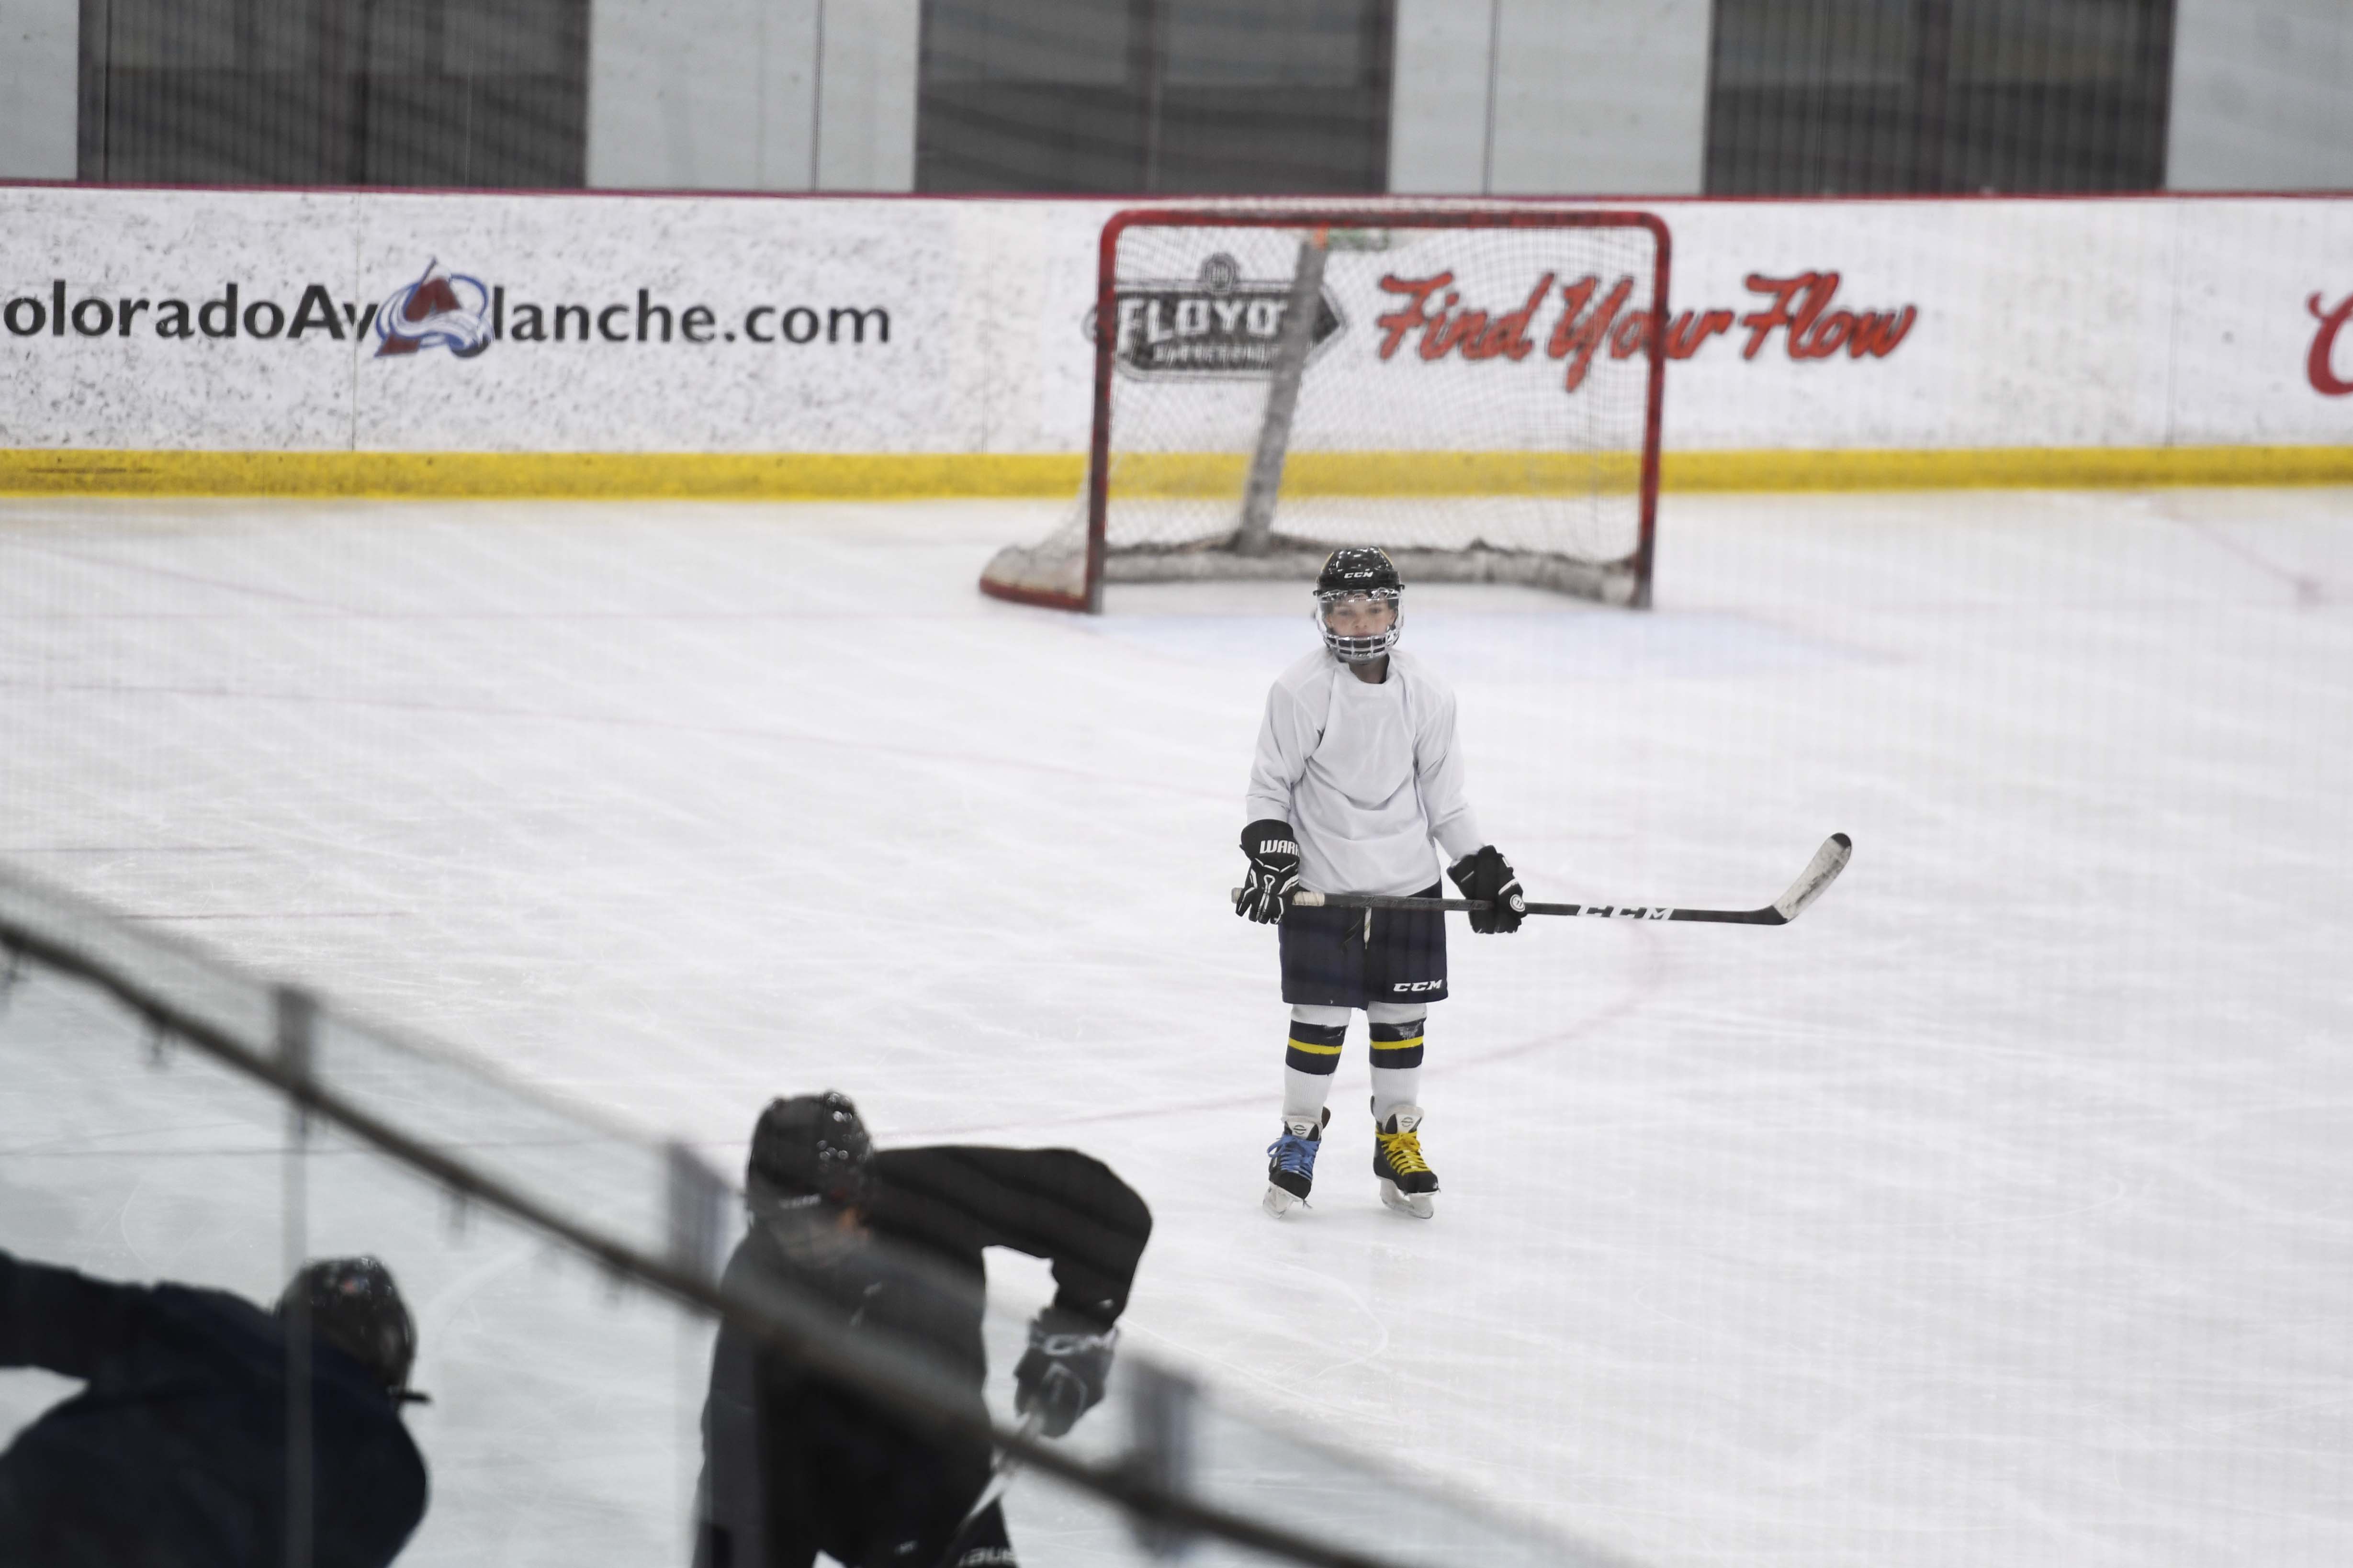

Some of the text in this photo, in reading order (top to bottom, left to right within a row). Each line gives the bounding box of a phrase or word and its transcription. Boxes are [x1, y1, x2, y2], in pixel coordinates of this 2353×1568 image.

[1376, 270, 1917, 393] Find Your Flow
[1576, 903, 1675, 920] CCM
[1393, 979, 1442, 992] CCM
